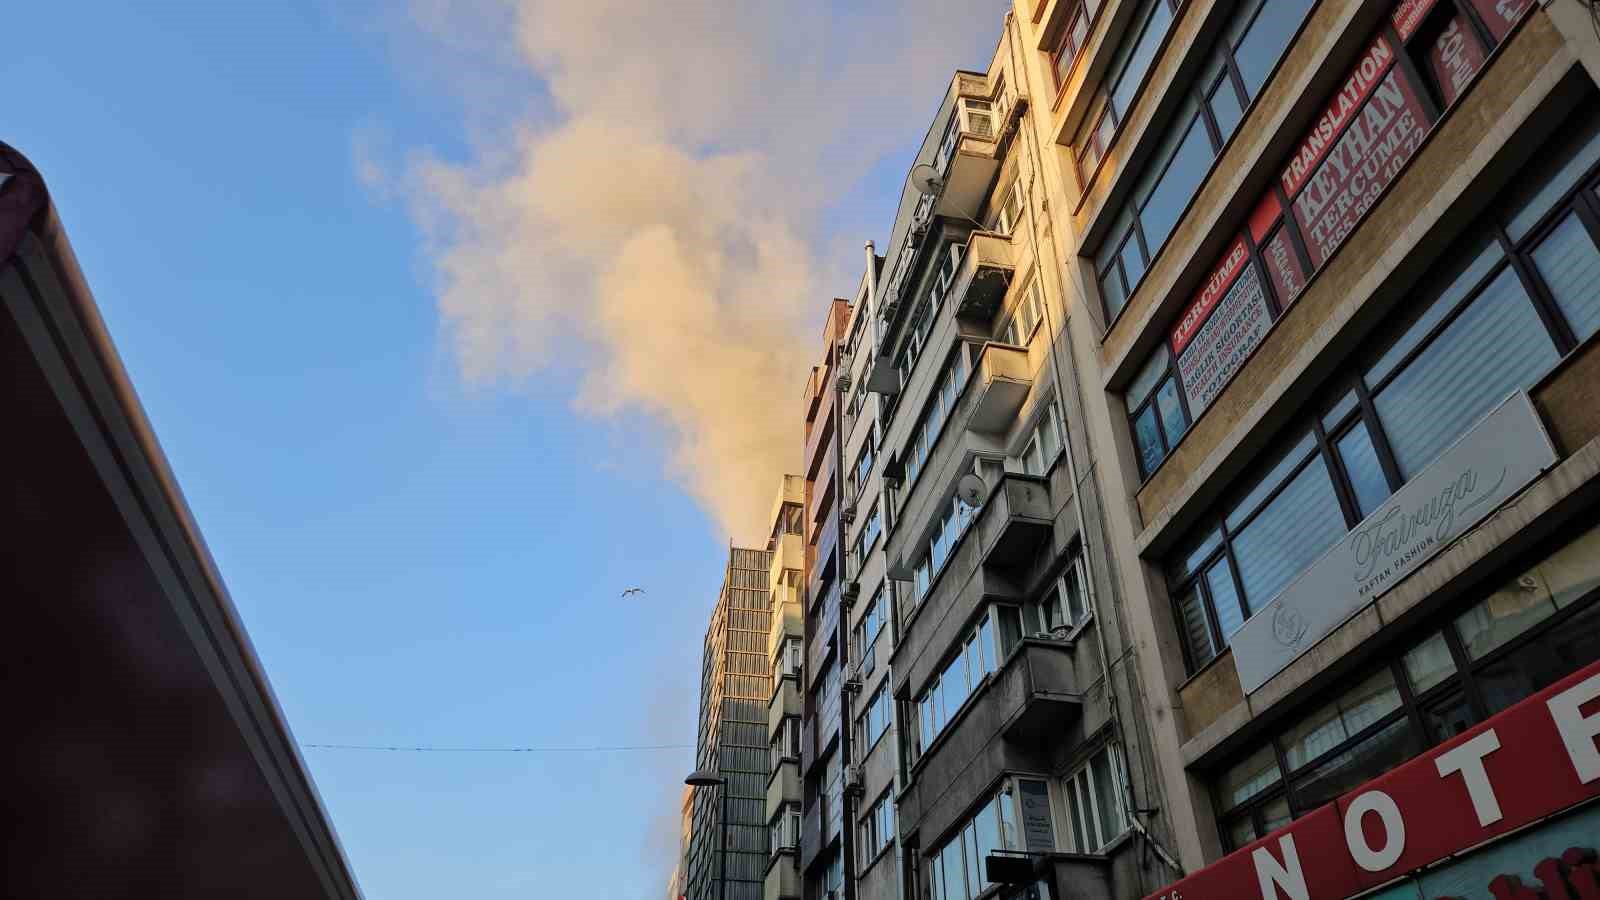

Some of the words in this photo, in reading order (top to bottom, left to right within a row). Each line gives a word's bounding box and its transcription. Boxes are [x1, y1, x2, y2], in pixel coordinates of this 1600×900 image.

[1283, 37, 1391, 188] TRANSLATION
[1299, 75, 1407, 228] KEYHAN
[1311, 110, 1415, 246] TERCÜME
[1175, 243, 1244, 343] TERCÜME
[1358, 568, 1392, 594] KAFTAN
[1393, 536, 1435, 570] FASHION
